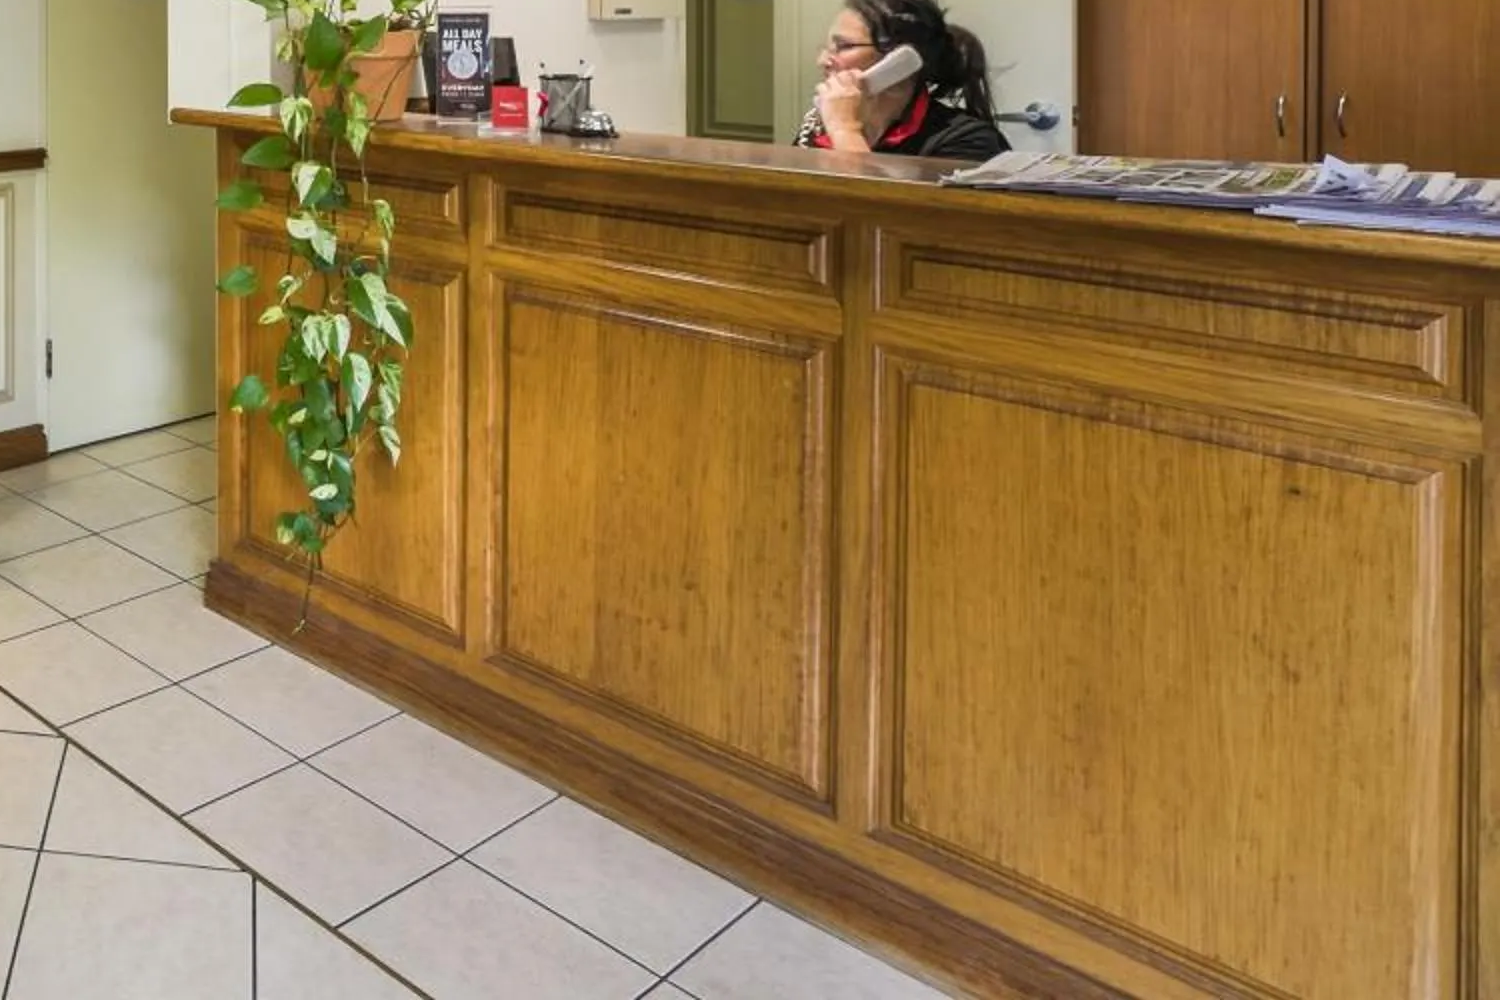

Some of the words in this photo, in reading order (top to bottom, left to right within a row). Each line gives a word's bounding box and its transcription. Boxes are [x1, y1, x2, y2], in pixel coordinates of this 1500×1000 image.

[443, 29, 460, 39] ALL
[462, 29, 482, 39] DAY
[442, 40, 483, 53] MEALS
